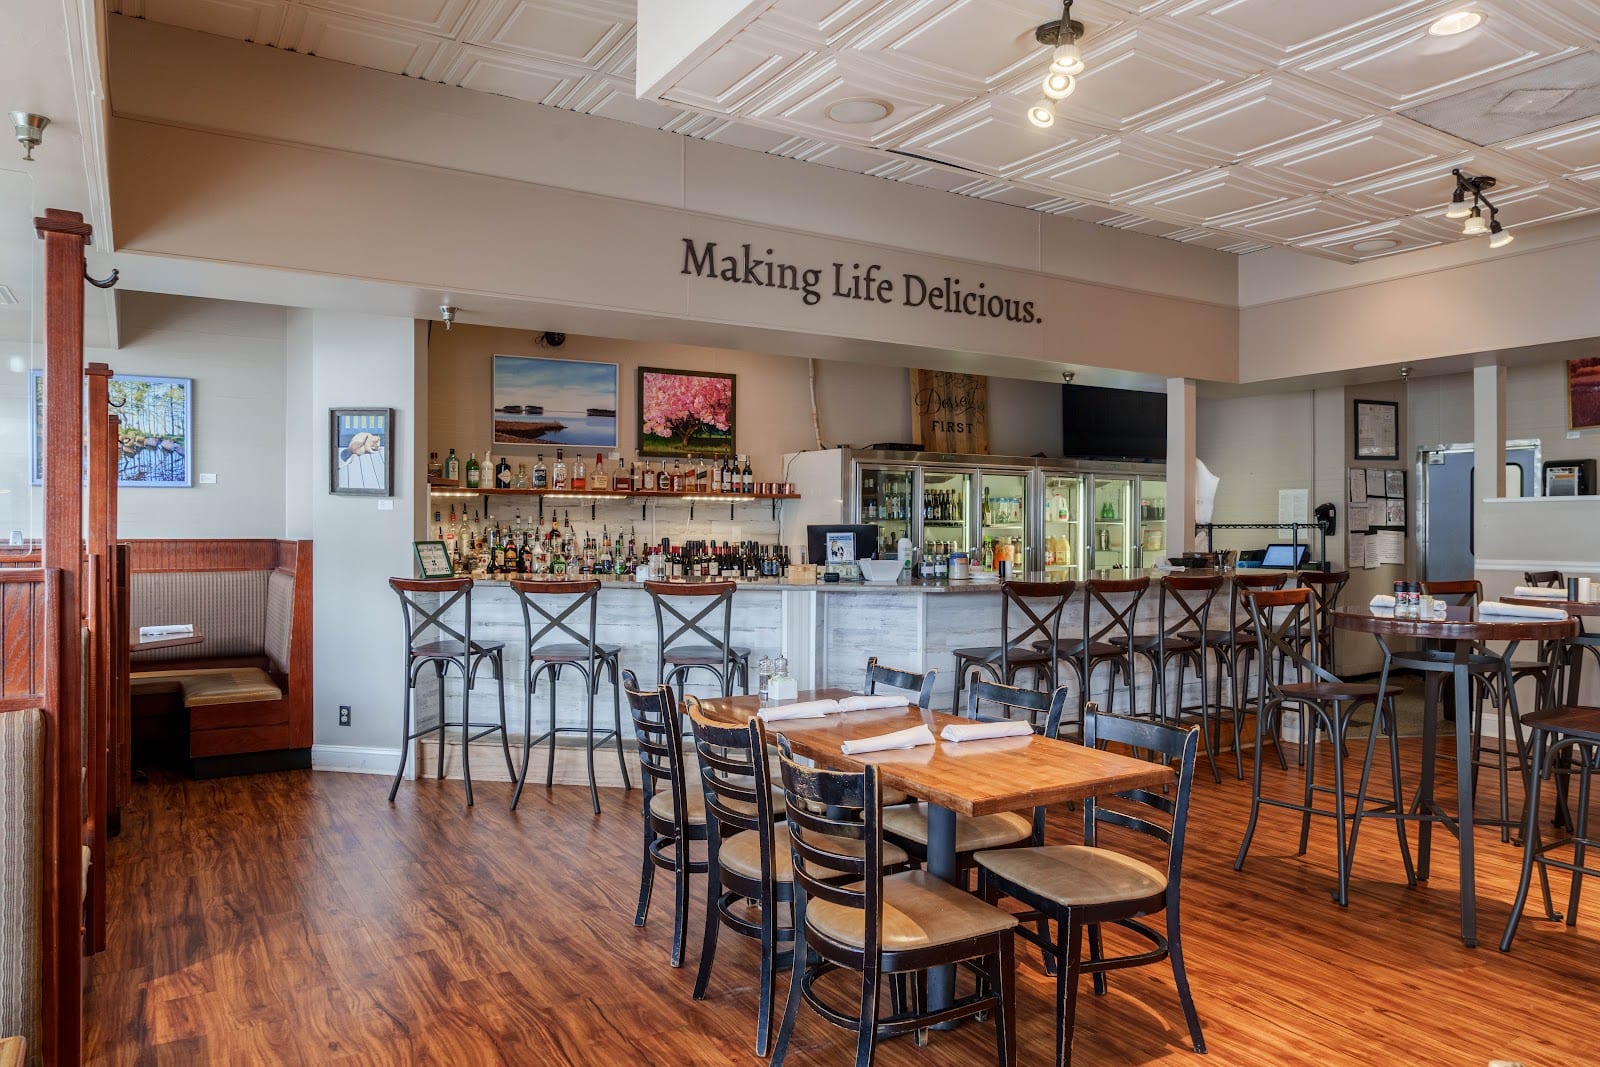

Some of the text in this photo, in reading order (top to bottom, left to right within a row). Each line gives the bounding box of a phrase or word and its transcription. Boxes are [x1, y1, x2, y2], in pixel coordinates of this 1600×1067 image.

[681, 238, 1043, 325] Making Life Delicious.
[931, 420, 974, 434] FIRST
